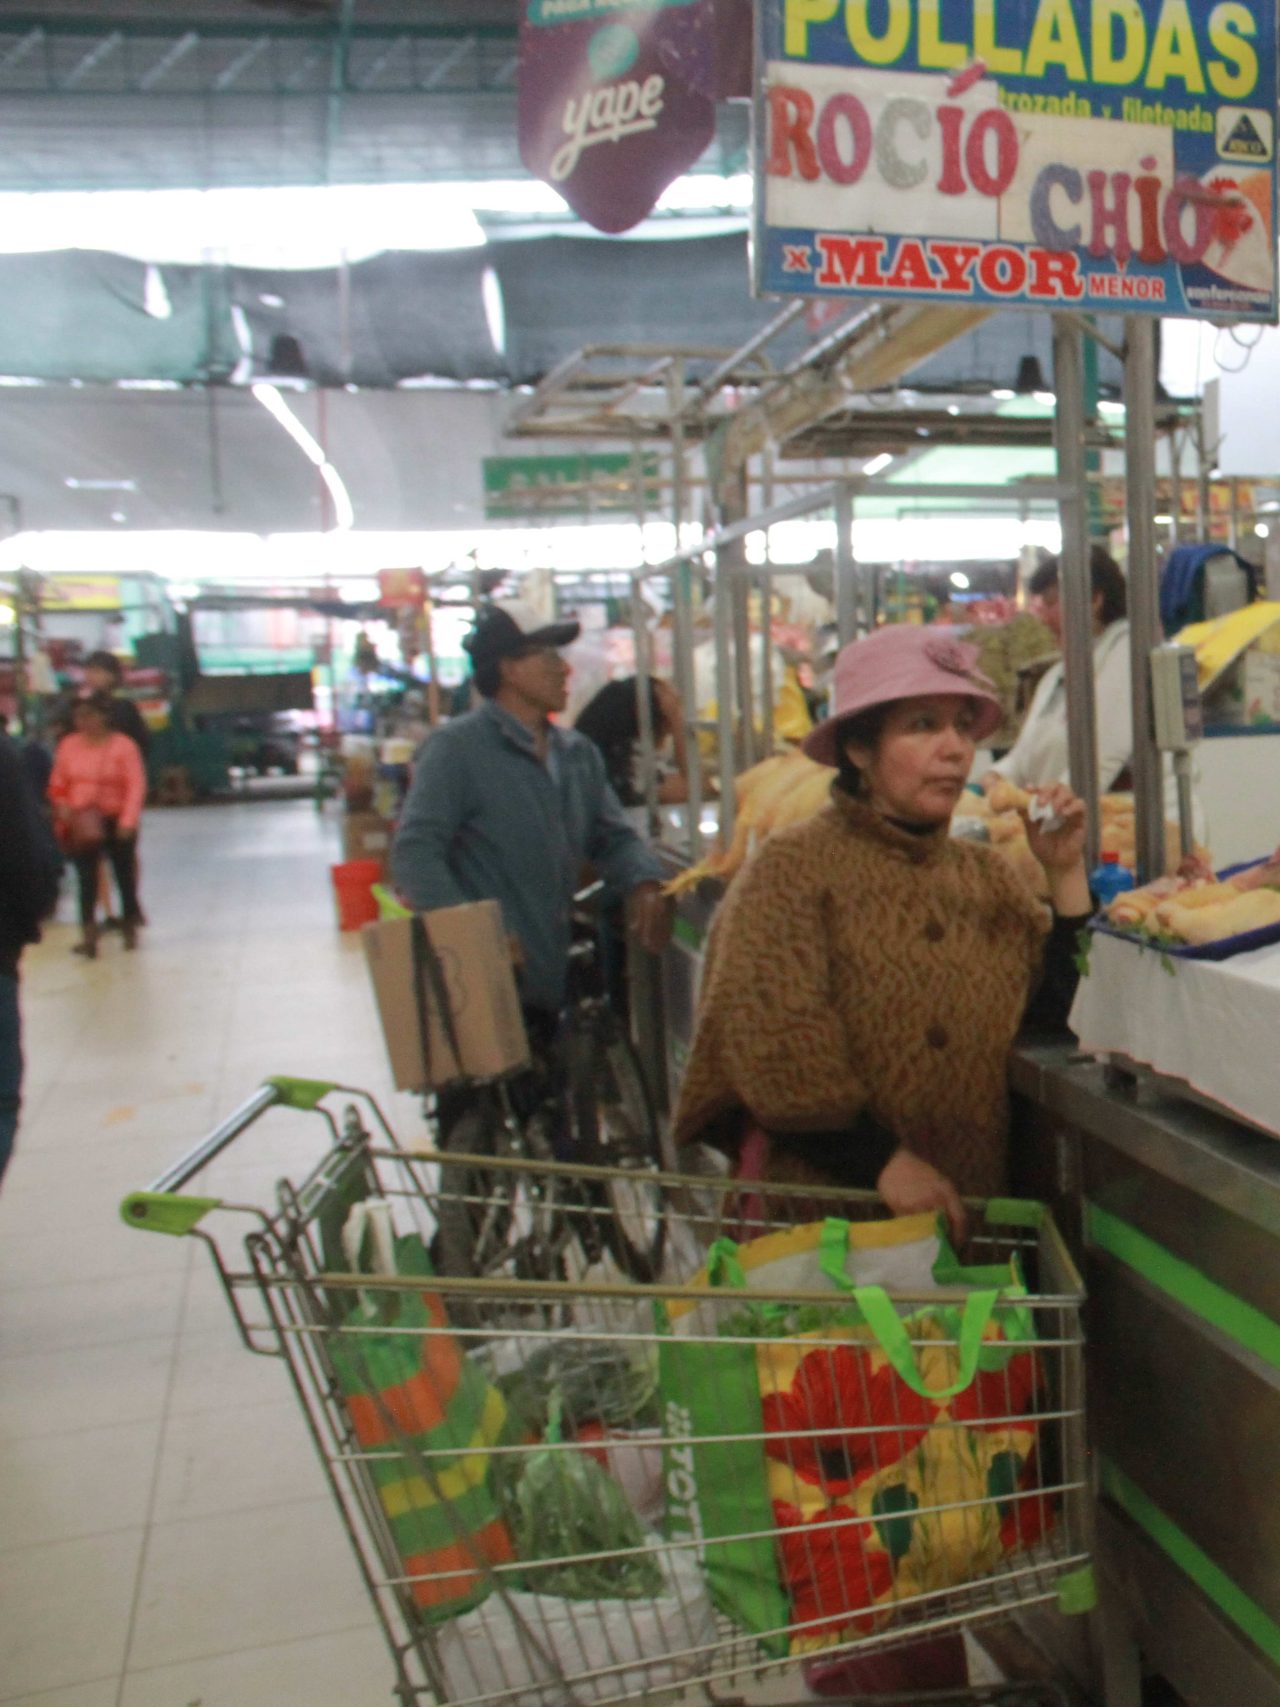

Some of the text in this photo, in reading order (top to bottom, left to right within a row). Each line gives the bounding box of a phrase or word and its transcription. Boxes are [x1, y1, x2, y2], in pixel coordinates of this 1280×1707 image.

[785, 0, 1259, 99] POLLADAS
[550, 73, 665, 182] yape
[764, 62, 1019, 198] ROCÍO
[816, 232, 1085, 300] MAYOR
[1086, 273, 1166, 301] MENOR
